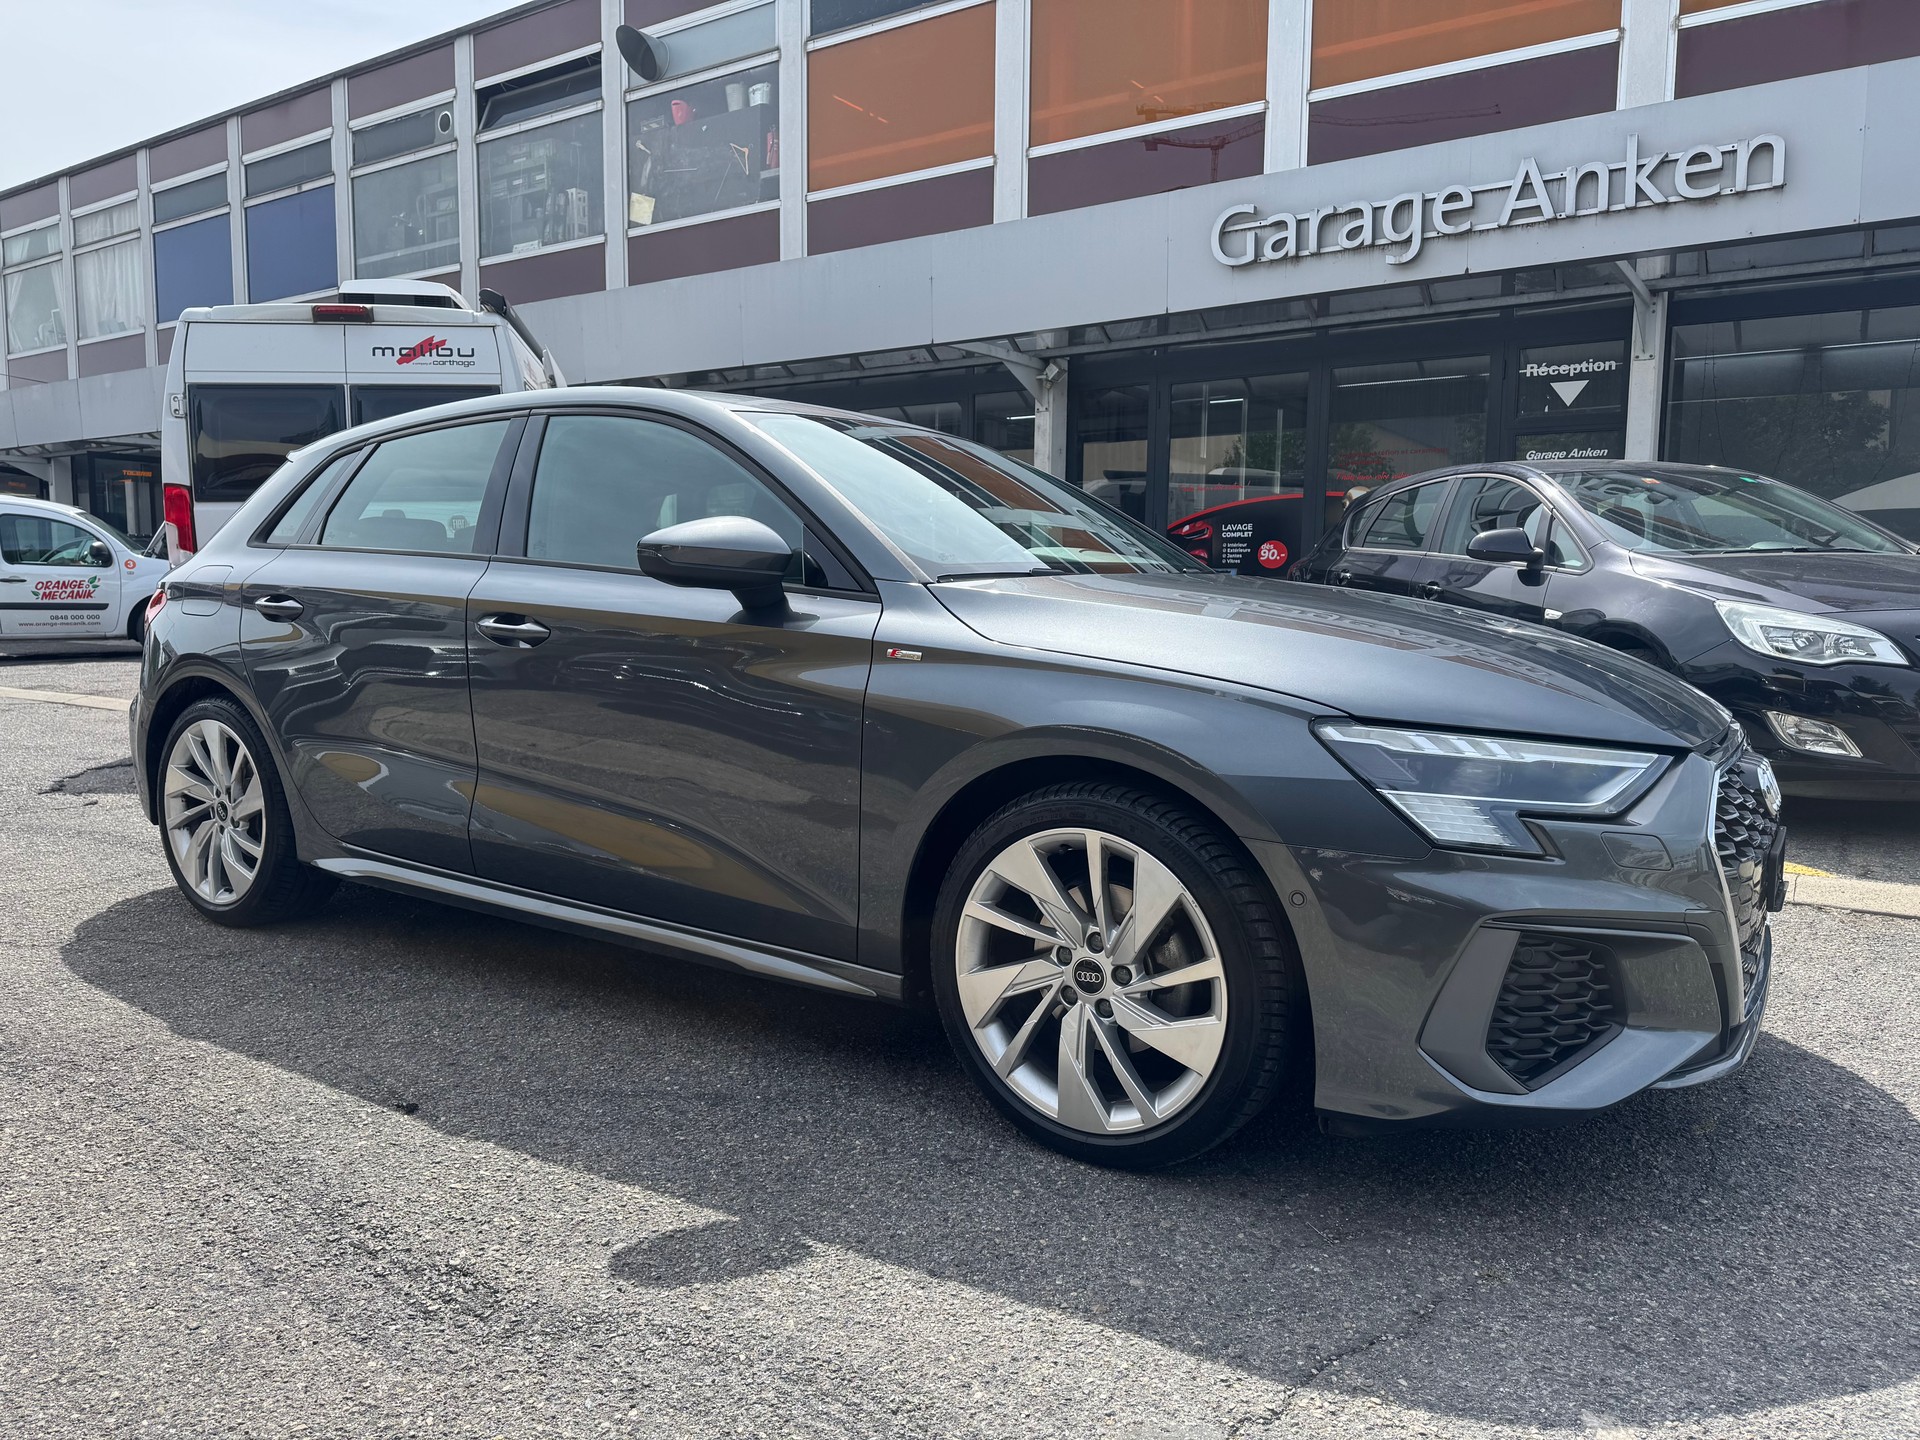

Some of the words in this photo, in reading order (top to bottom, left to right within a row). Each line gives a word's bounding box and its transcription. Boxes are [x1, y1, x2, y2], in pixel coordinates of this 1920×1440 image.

[1210, 183, 1474, 267] Garage
[1498, 132, 1787, 227] Anken
[372, 343, 475, 357] malibu
[432, 360, 475, 368] carthago
[1526, 359, 1616, 377] Réception
[1526, 450, 1566, 460] Garage
[1568, 448, 1608, 458] Anken
[1222, 523, 1253, 531] LAVAGE
[1260, 549, 1285, 560] 90.-
[127, 560, 133, 568] 3
[35, 580, 86, 591] ORANGE
[40, 589, 96, 600] MECANIK
